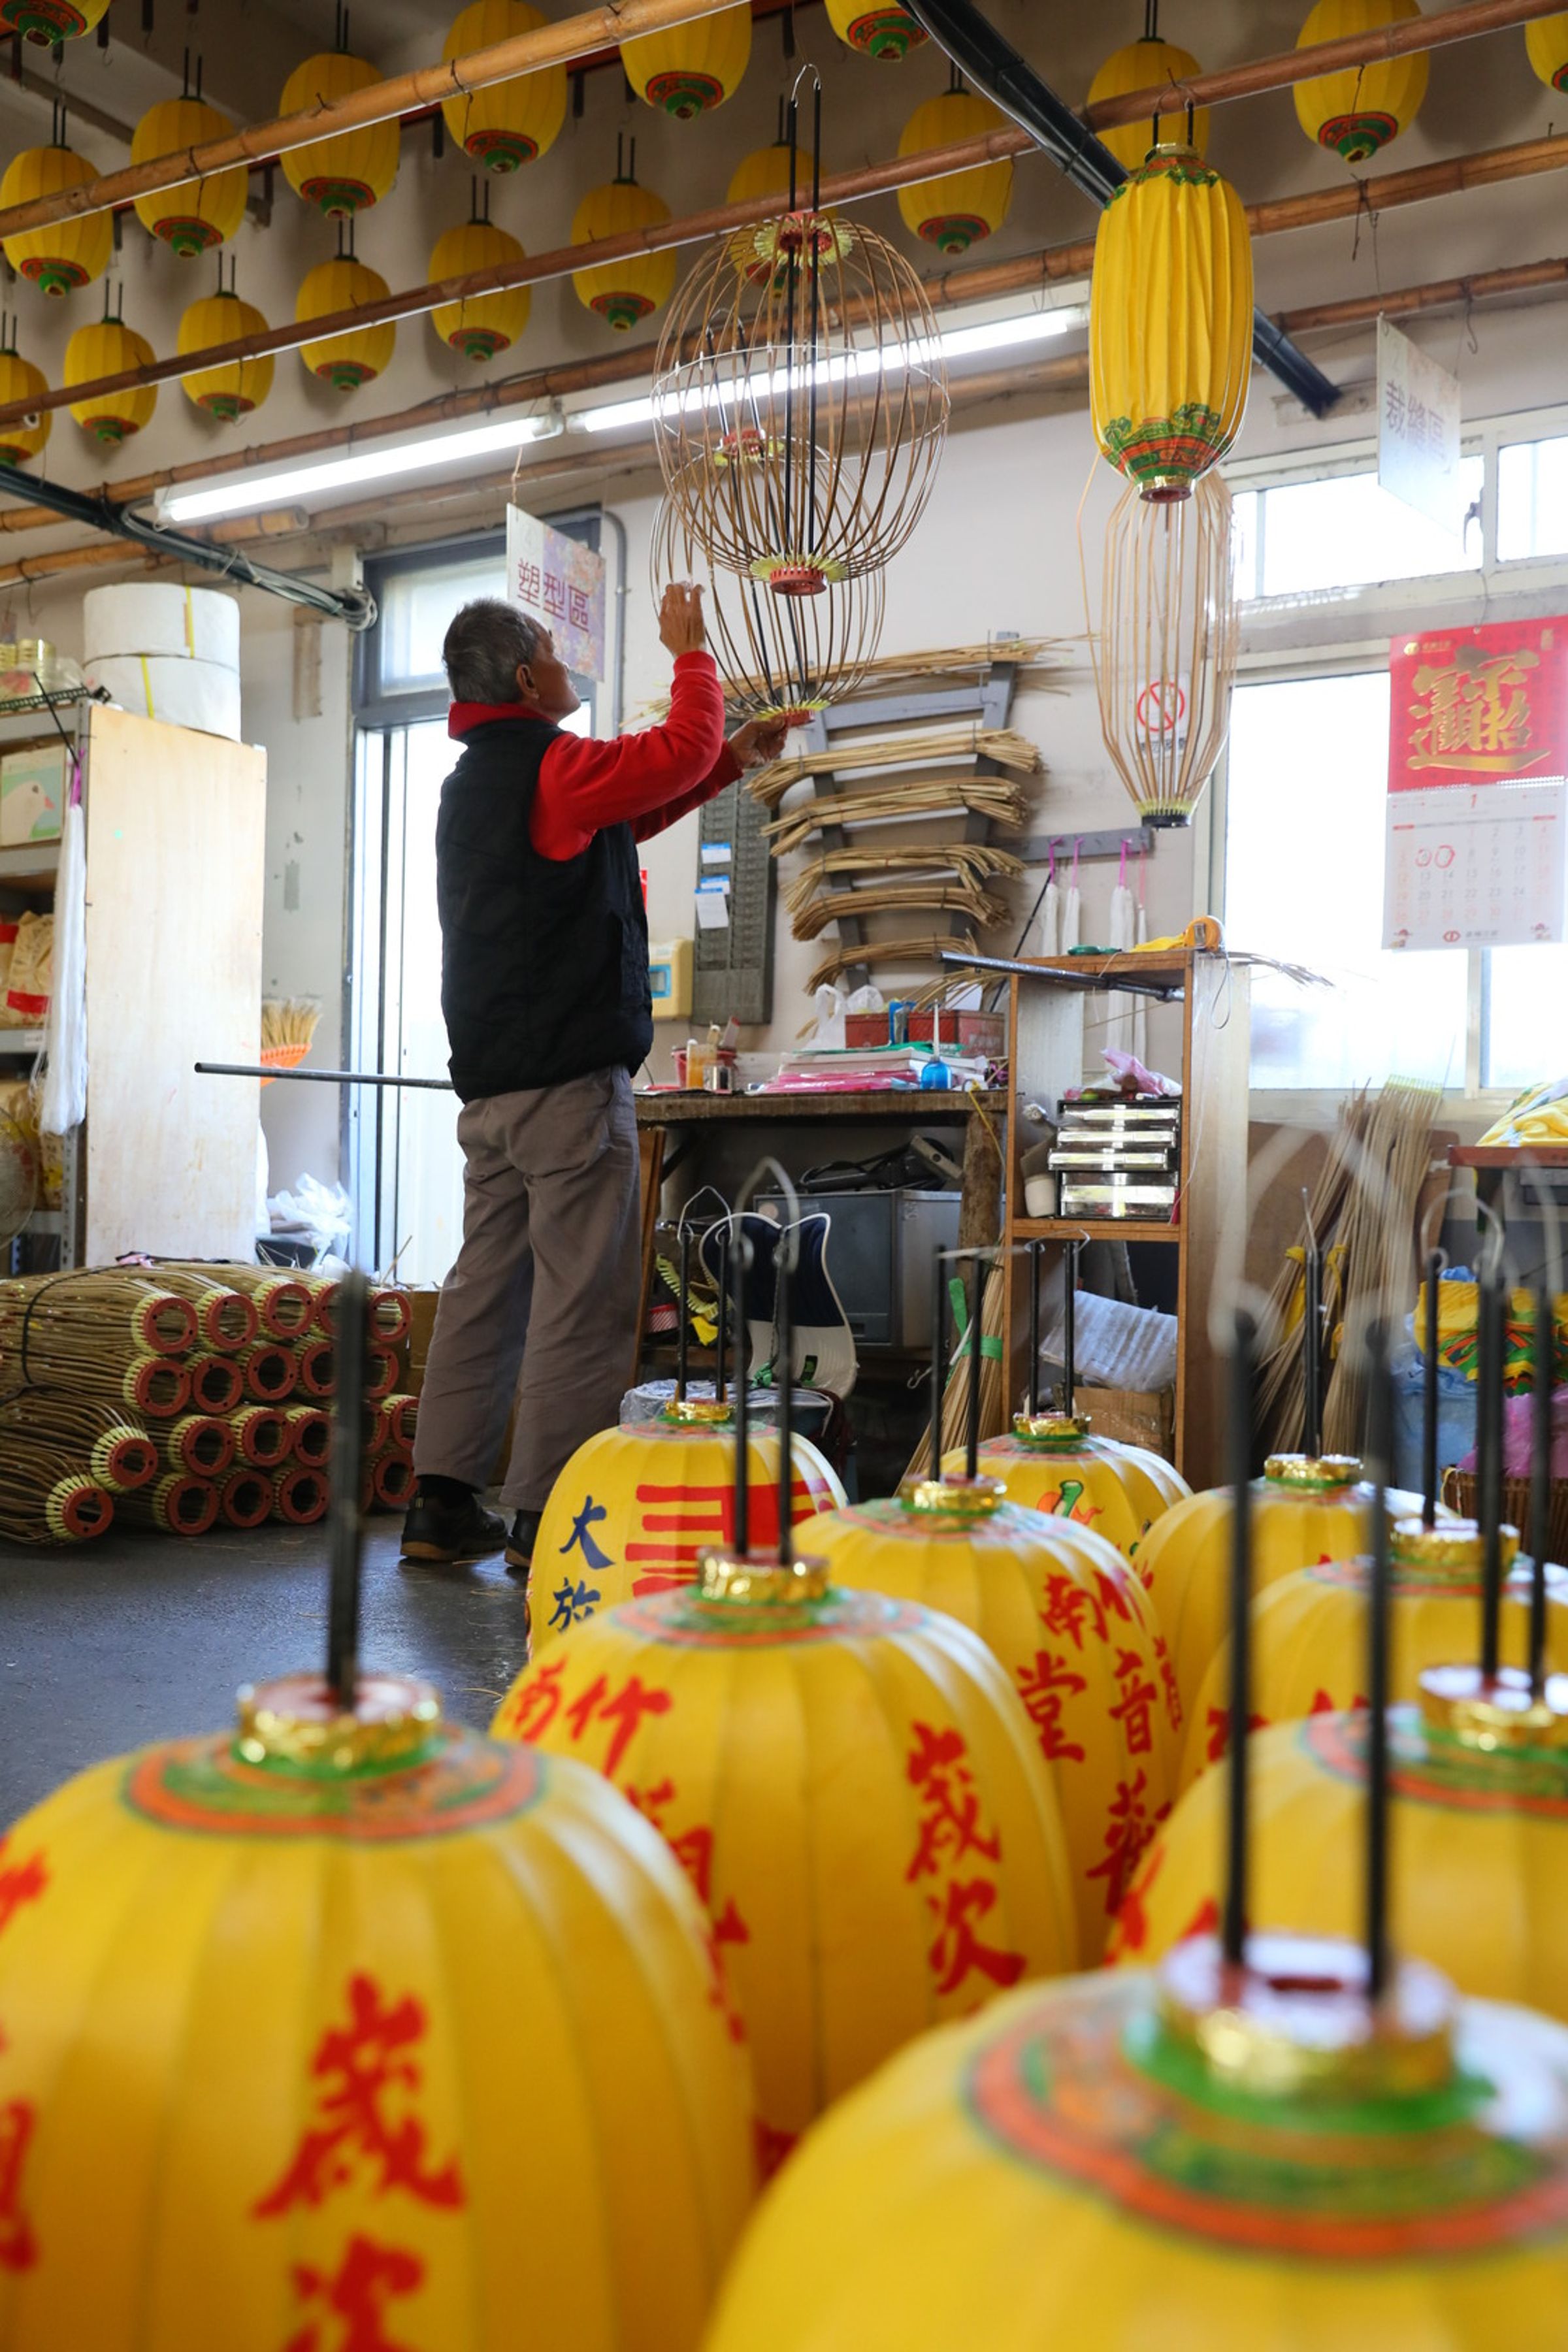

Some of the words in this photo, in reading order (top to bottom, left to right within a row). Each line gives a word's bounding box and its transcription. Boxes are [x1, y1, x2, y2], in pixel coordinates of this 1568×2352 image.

[517, 557, 589, 632] 塑型區
[1471, 793, 1477, 809] 1
